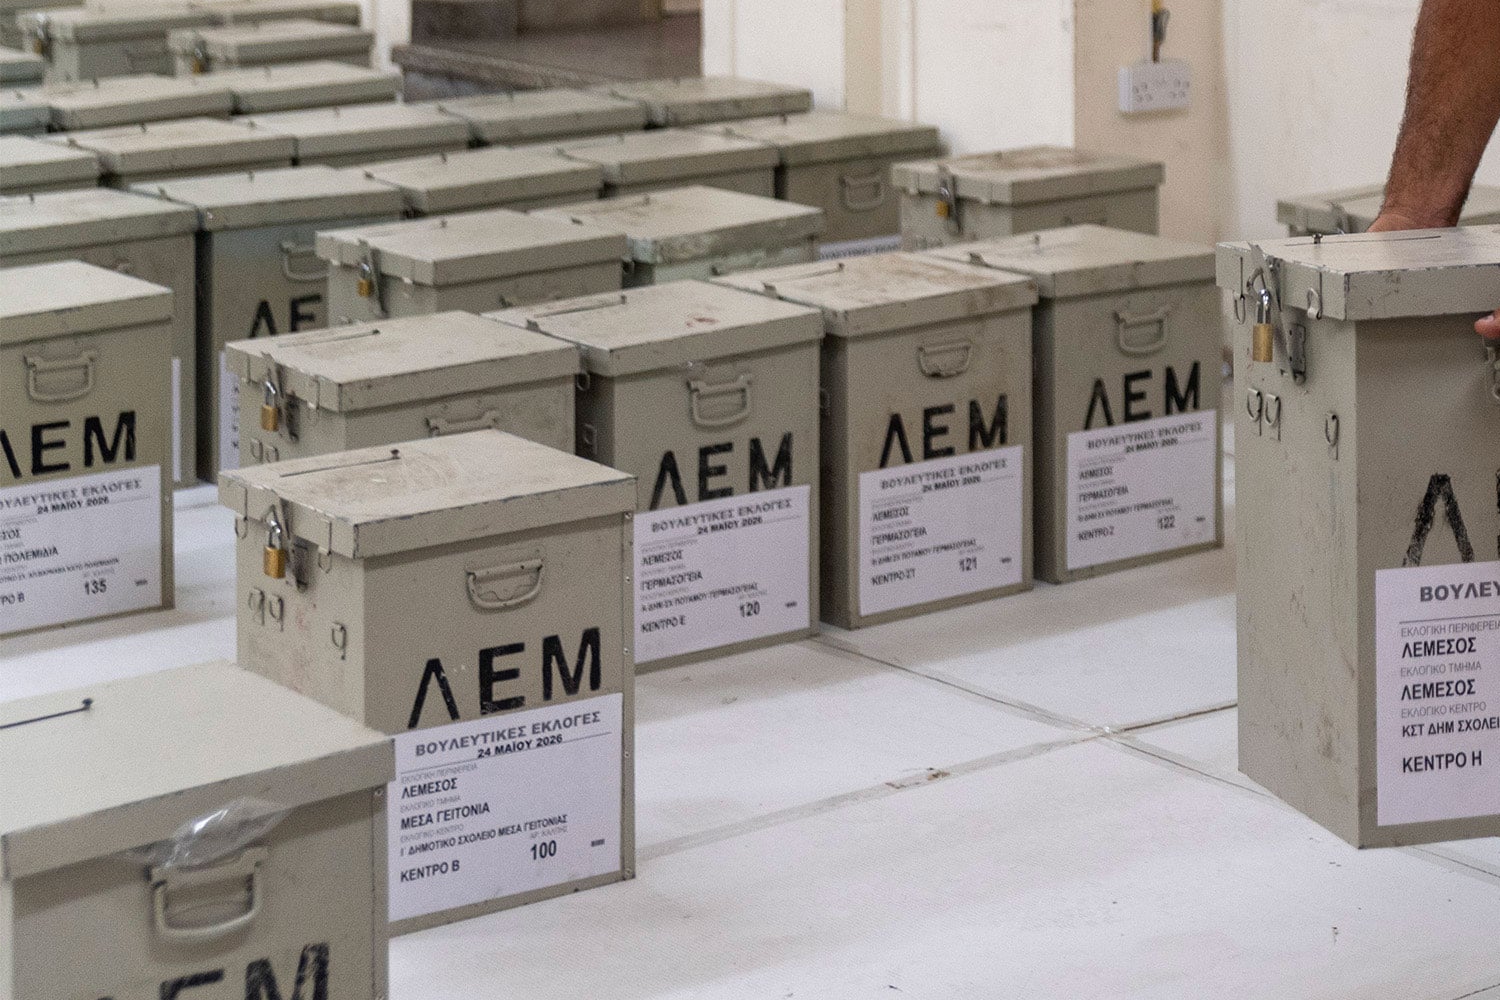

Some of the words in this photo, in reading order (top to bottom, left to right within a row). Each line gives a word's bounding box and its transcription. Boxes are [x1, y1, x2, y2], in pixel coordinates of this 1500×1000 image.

[250, 295, 322, 338] ΛΕ
[1084, 361, 1200, 430] ΛΕΜ
[880, 393, 1008, 468] ΛΕΜ
[650, 431, 792, 510] ΛΕΜ
[0, 488, 78, 510] ΥΛΕΥΤΙΚΕΣ
[82, 480, 141, 497] ΕΚΛΟΓΕΣ
[652, 509, 735, 533] ΒΟΥΛΕΥΤΙΚΕΣ
[738, 498, 792, 517] ΕΚΛΟΓΕΣ
[85, 579, 108, 595] 135
[739, 600, 760, 618] 120
[1401, 625, 1446, 638] ΕΚΛΟΓΙΚΗ
[1402, 637, 1477, 659] ΛΕΜΕΣΟΣ
[408, 626, 600, 729] ΛΕΜ
[1400, 663, 1446, 677] ΕΚΛΟΓΙΚΟ
[1449, 661, 1482, 673] ΤΜΗΜΑ
[1401, 679, 1476, 701] ΛΕΜΕΣΟΣ
[1401, 705, 1447, 719] ΕΚΛΟΓΙΚΟ
[1449, 701, 1487, 714] ΚΕΝΤΡΟ
[416, 725, 526, 757] ΒΟΥΛΕΥΤΙΚΕΣ
[532, 711, 601, 735] ΕΚΛΟΓΕΣ
[1402, 724, 1425, 737] ΚΣΤ
[1428, 721, 1454, 735] ΔΗΜ
[477, 748, 491, 759] 24
[536, 734, 563, 748] 2026
[1403, 751, 1467, 773] ΚΕΝΤΡΟ
[1472, 750, 1482, 766] Η
[401, 777, 458, 799] ΛΕΜΕΣΟΣ
[401, 813, 434, 830] ΜΕΣΑ
[436, 802, 490, 823] ΓΕΙΤΟΝΙΑ
[408, 837, 455, 856] ΔΗΜΟΤΙΚΟ
[457, 830, 496, 846] ΣΧΟΛΕΙΟ
[498, 824, 522, 837] ΜΕΣΑ
[524, 814, 568, 832] ΓΕΙΤΟΝΙΑΣ
[530, 840, 557, 860] 100
[401, 862, 449, 882] ΚΕΝΤΡΟ
[451, 860, 460, 872] Β
